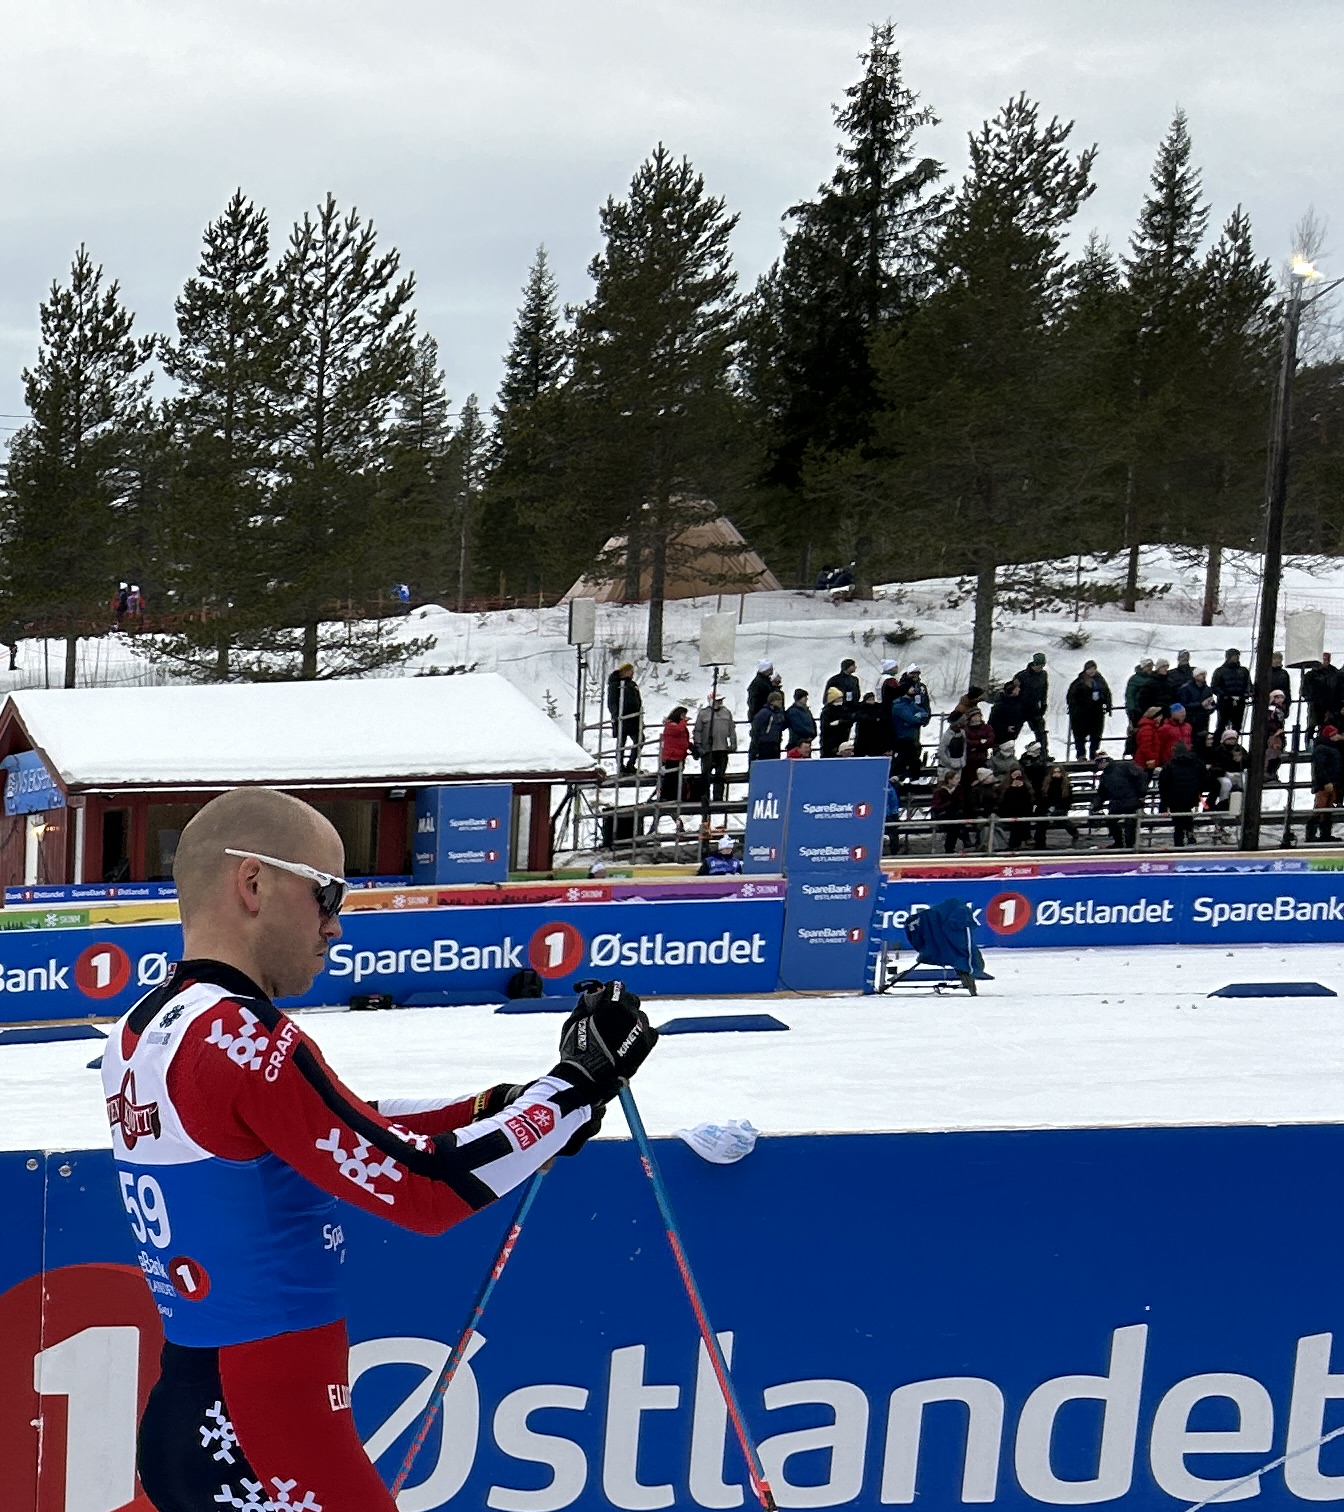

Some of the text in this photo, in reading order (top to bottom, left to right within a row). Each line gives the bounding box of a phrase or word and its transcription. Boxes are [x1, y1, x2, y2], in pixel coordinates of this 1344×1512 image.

[752, 792, 780, 820] MÅL
[802, 803, 854, 815] SpareBank
[798, 846, 850, 858] SpareBank
[801, 884, 853, 896] SpareBank
[1035, 899, 1175, 927] Østlandet
[1192, 895, 1344, 928] SpareBank
[797, 927, 848, 939] SpareBank
[328, 937, 523, 983] SpareBank
[589, 931, 766, 969] Østlandet
[264, 1021, 298, 1083] CRAFT
[507, 1119, 531, 1151] NOR
[118, 1170, 172, 1249] 59
